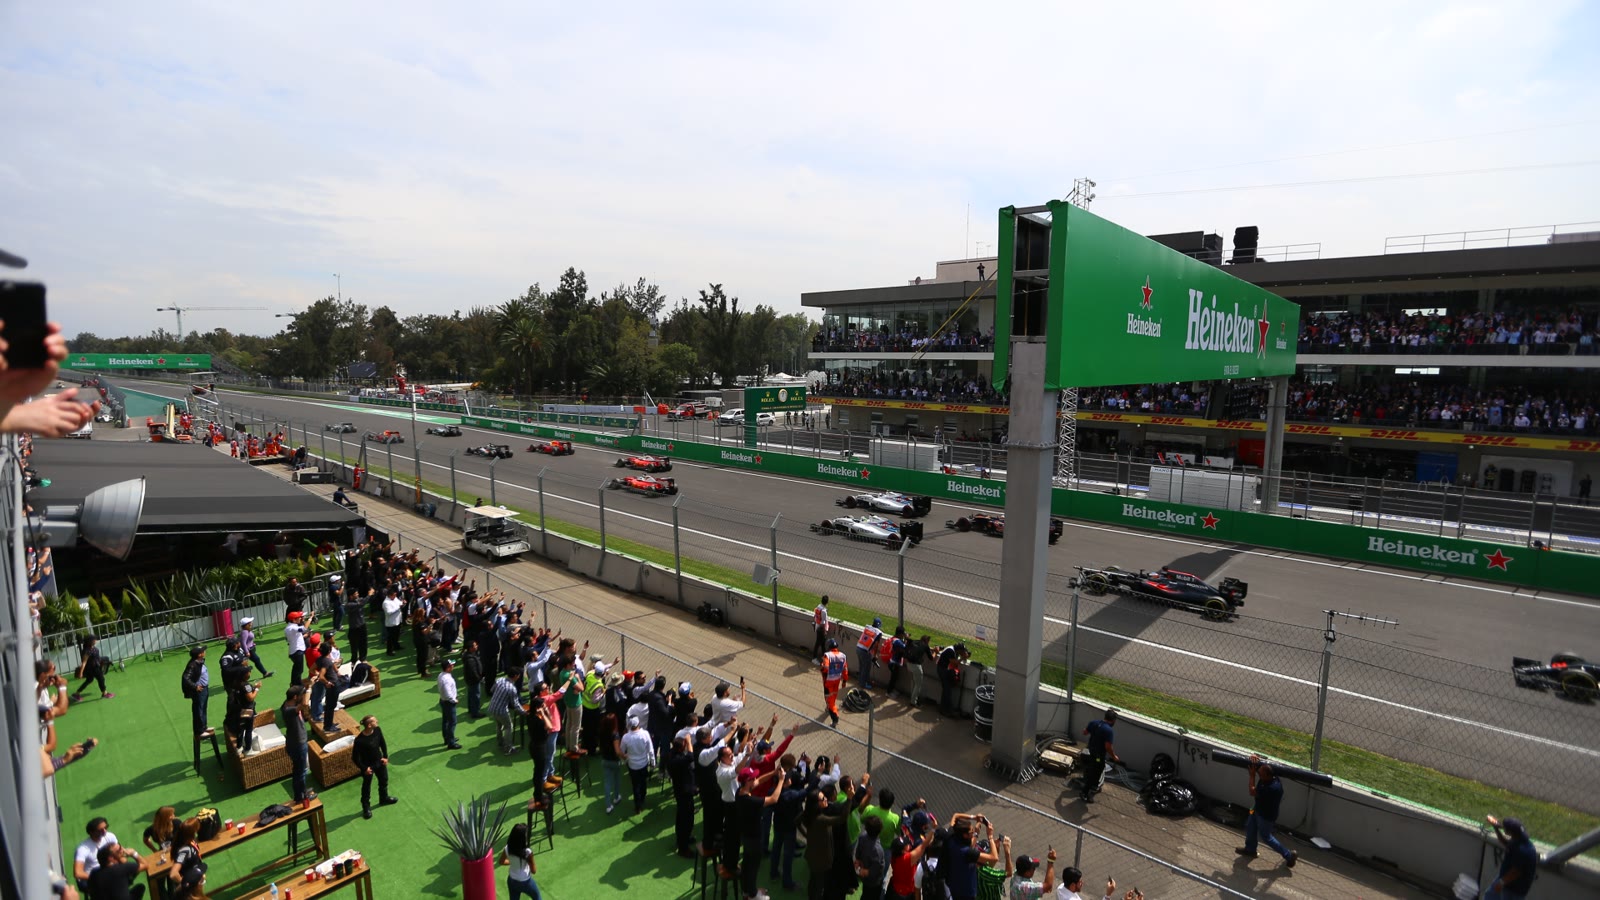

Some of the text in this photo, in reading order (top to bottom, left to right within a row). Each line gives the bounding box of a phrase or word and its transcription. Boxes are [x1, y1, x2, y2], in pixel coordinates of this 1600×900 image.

[1126, 313, 1161, 337] Heineken
[1185, 288, 1254, 353] Heineken
[108, 357, 153, 365] Heineken
[1091, 413, 1122, 421] DHL
[1151, 416, 1186, 425] DHL
[1215, 420, 1256, 430] DHL
[1288, 423, 1332, 434] DHL
[1369, 429, 1421, 440] DHL
[1462, 434, 1520, 446] DHL
[641, 439, 667, 451] Heineken
[721, 450, 753, 463] Heineken
[817, 463, 858, 478] Heineken
[947, 480, 1000, 498] Heineken
[1122, 503, 1196, 526] Heineken
[1368, 536, 1476, 565] Heineken
